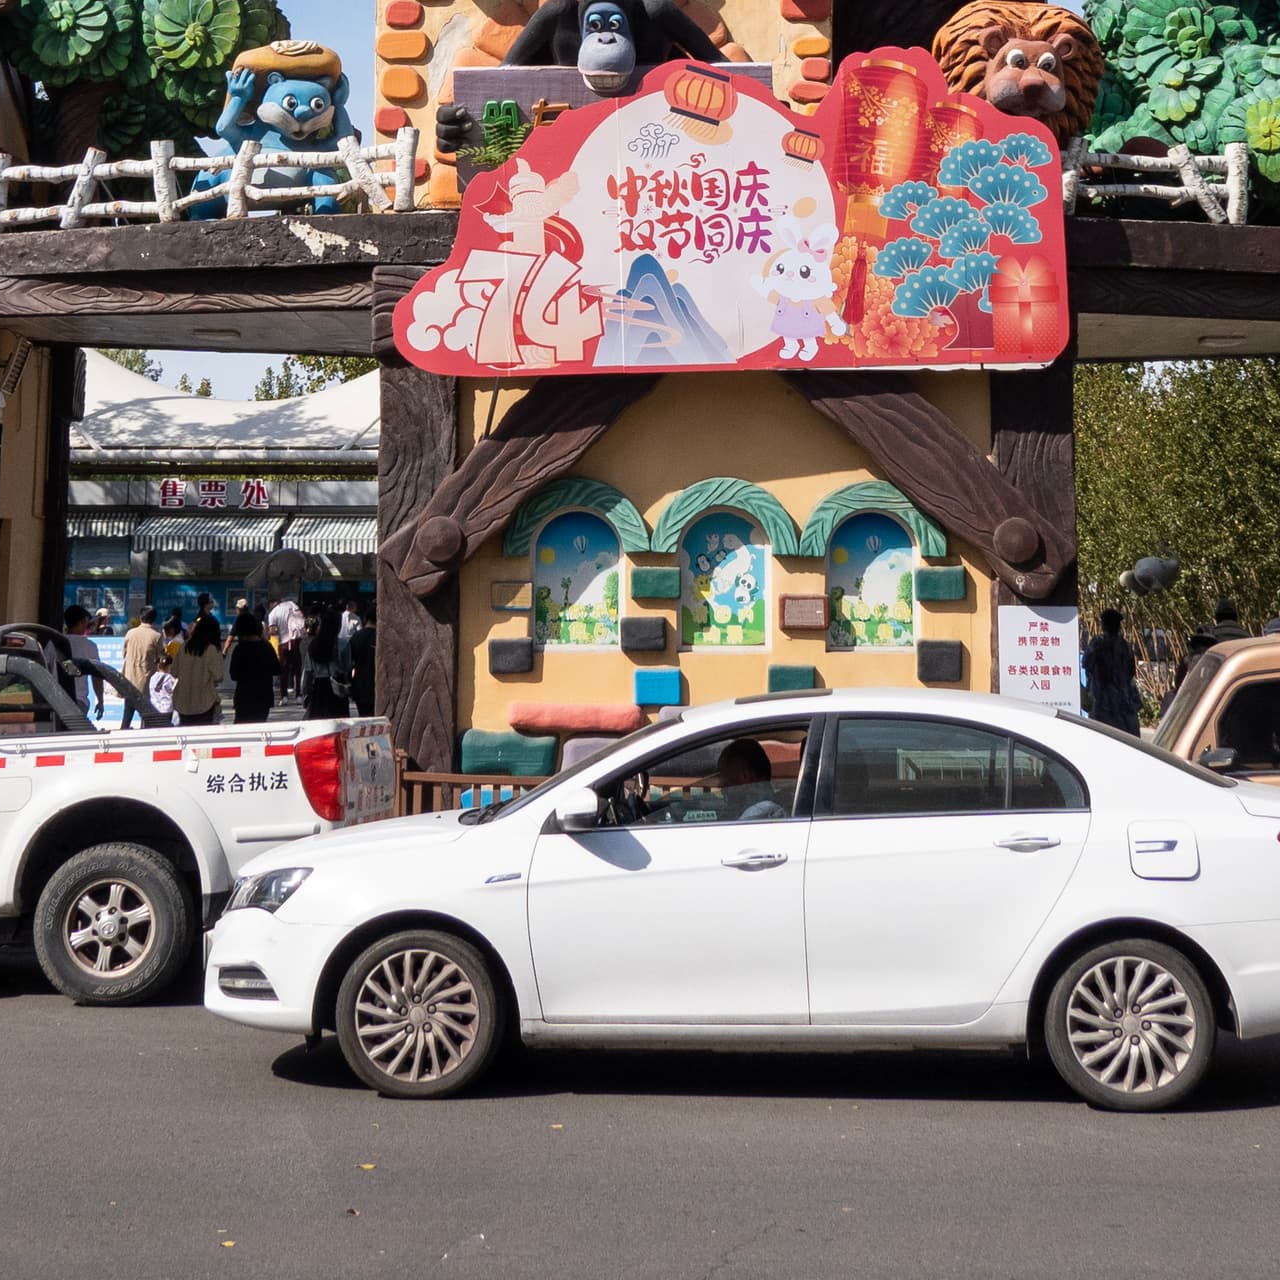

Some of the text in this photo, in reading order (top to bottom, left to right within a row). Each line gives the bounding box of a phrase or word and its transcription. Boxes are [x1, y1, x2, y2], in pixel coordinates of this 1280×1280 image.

[607, 160, 771, 217] 中秋国庆
[614, 207, 773, 259] 双节同庆
[454, 249, 605, 365] 74
[159, 478, 270, 509] 售票处
[1028, 622, 1049, 632] 严禁
[1018, 636, 1060, 647] 携带宠物
[1034, 651, 1045, 661] 及
[1008, 665, 1072, 676] 各类投喂食物
[1030, 680, 1051, 690] 入园
[206, 770, 289, 794] 综合执法
